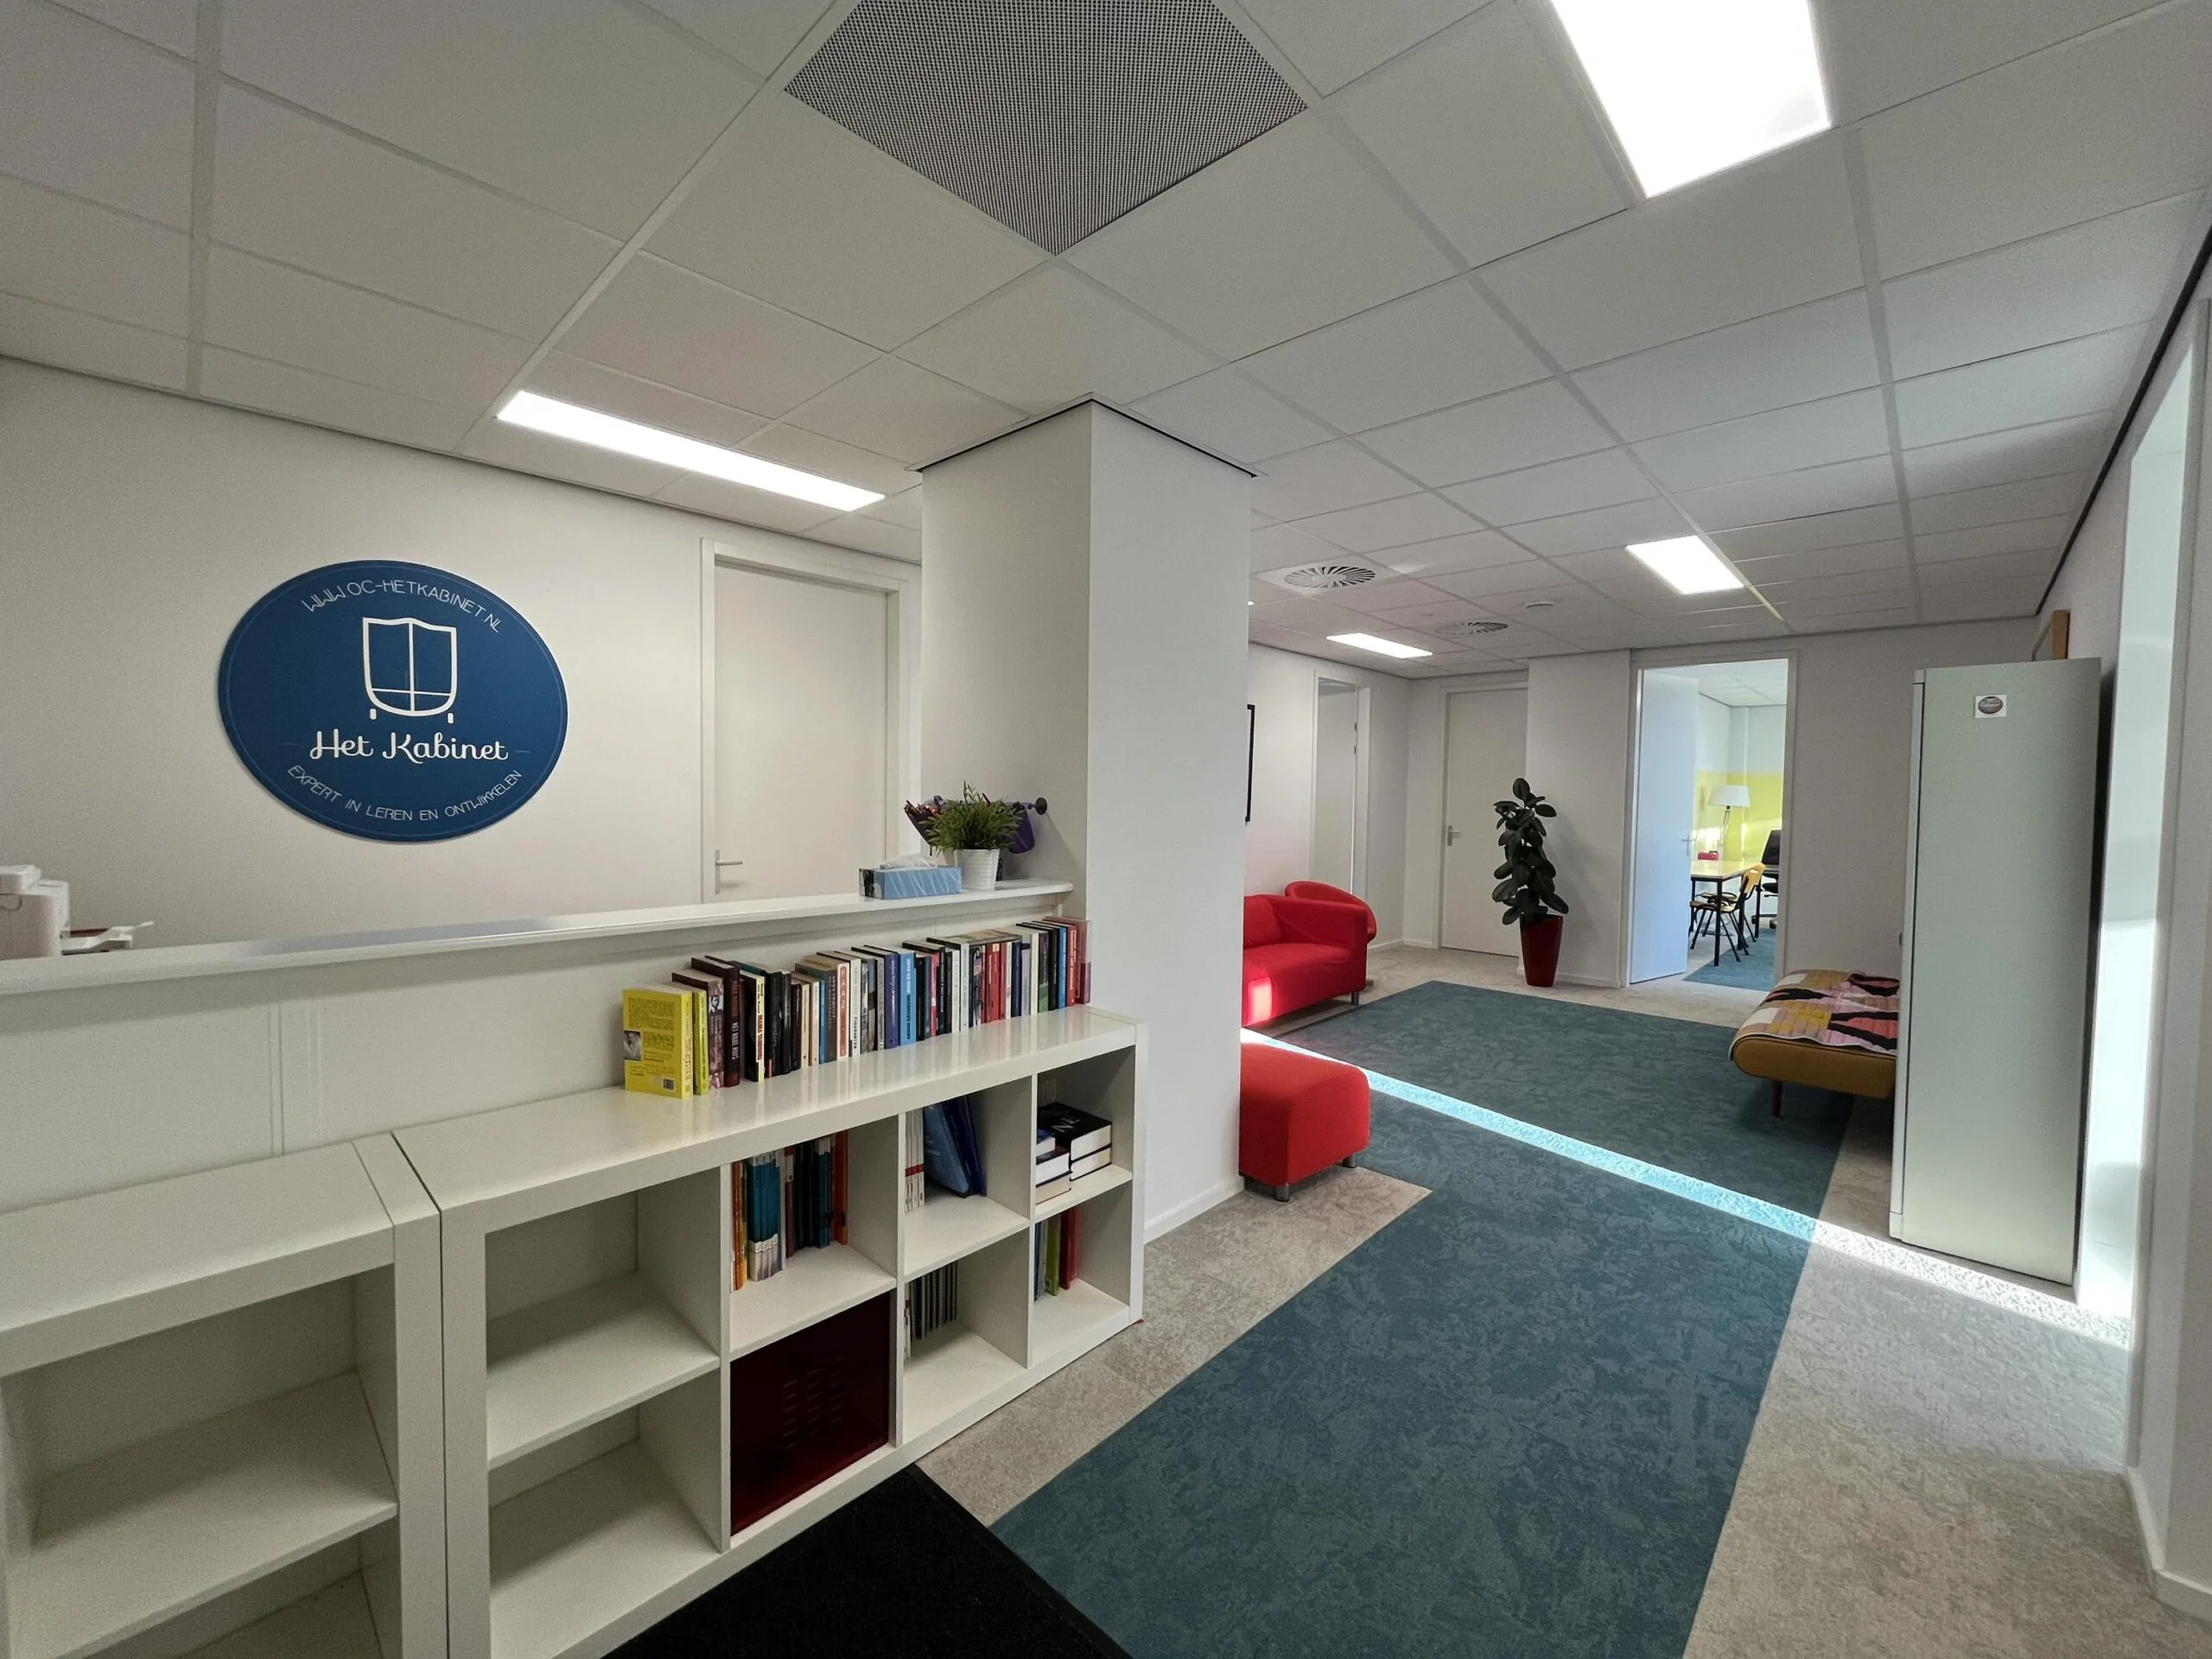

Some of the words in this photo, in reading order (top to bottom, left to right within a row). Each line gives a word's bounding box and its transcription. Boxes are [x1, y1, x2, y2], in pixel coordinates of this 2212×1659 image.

[301, 579, 503, 633] WWW.OC-HETKABINET.NL
[309, 728, 374, 760] Het
[382, 732, 509, 764] Kabinet
[287, 765, 342, 803] EXPERT
[346, 798, 361, 812] IN
[366, 802, 413, 821] LEREN
[419, 809, 439, 821] EN
[444, 770, 523, 817] ONTWIKKELEN
